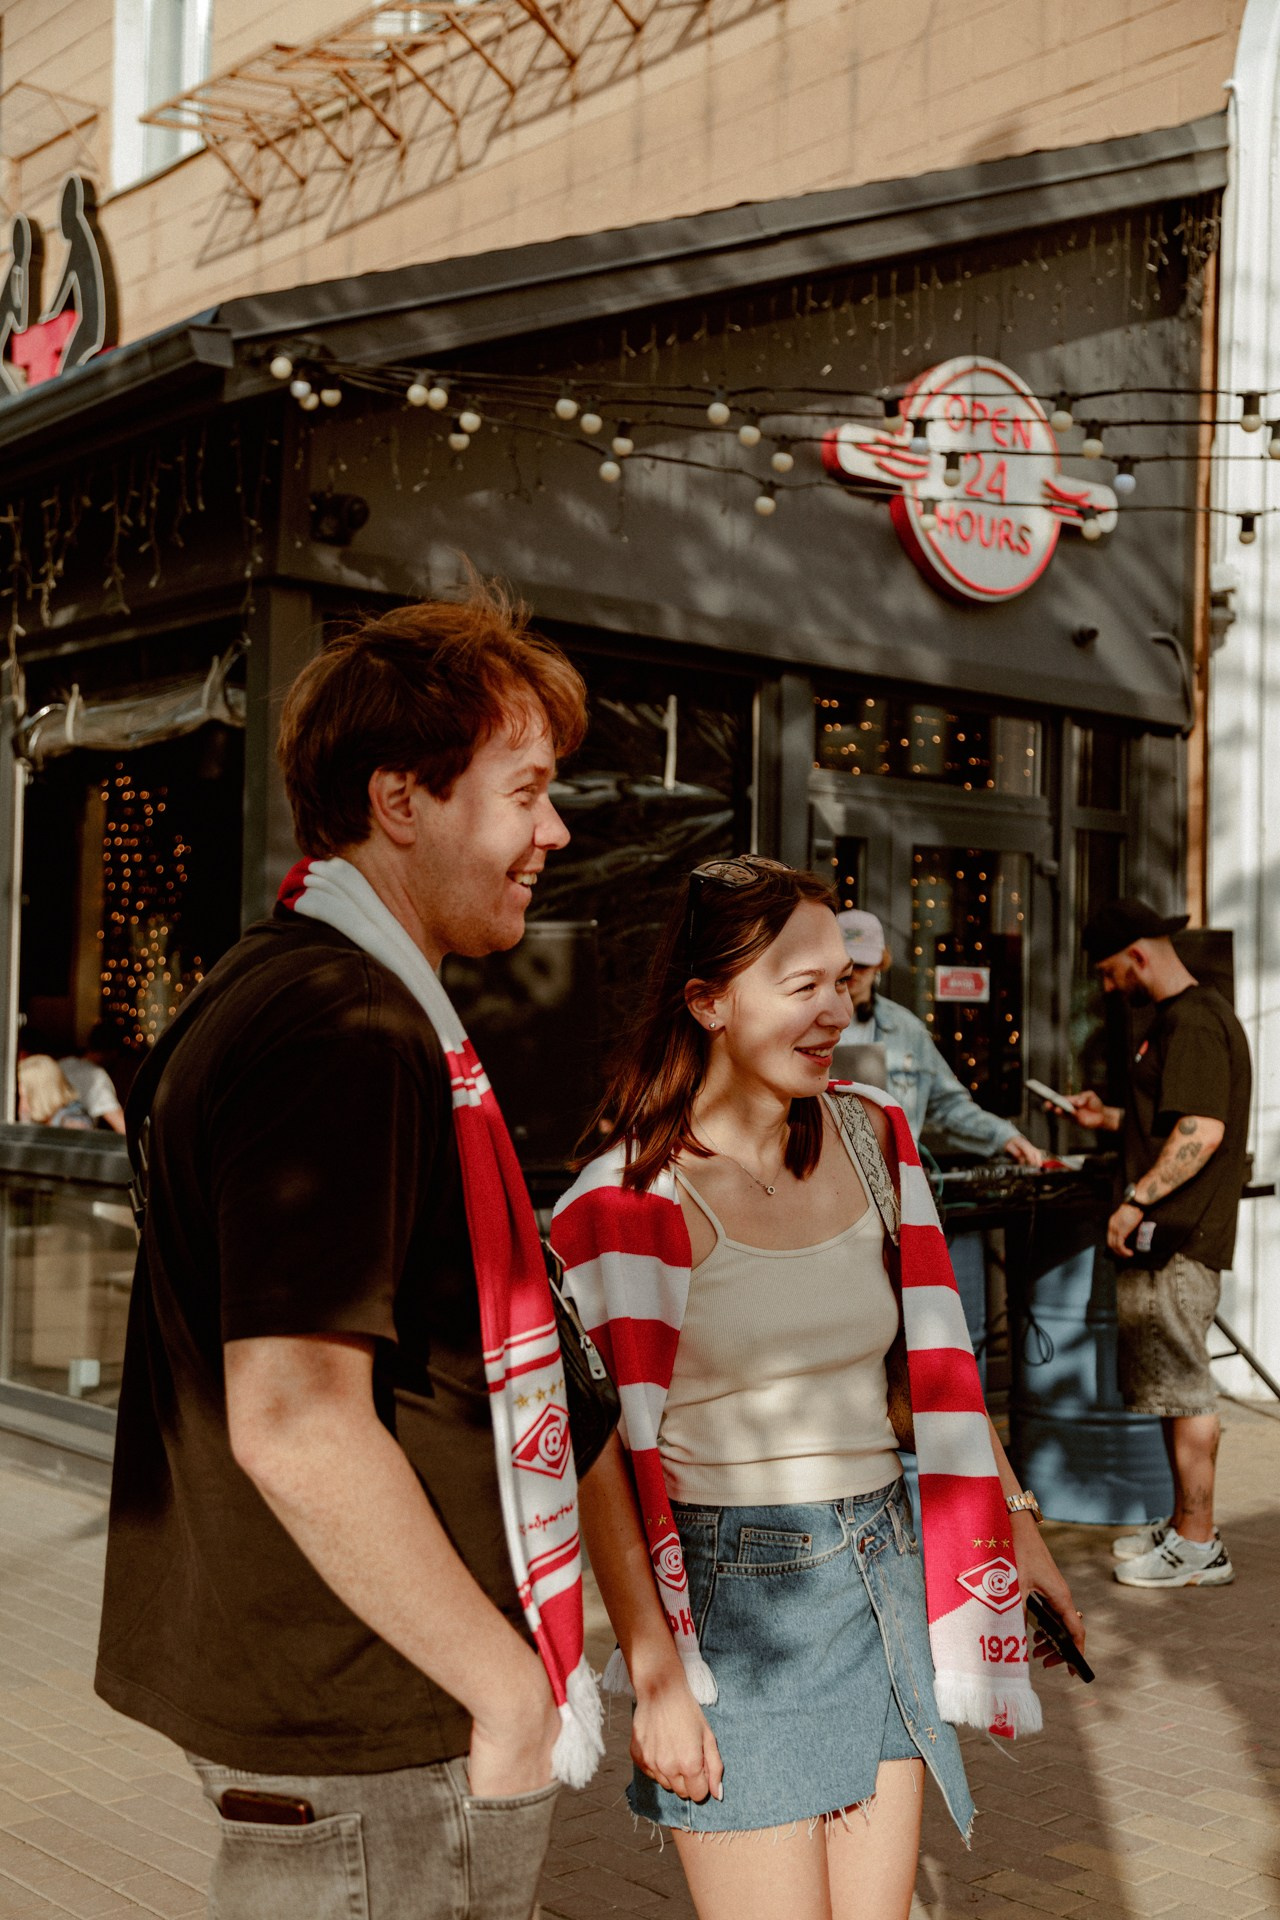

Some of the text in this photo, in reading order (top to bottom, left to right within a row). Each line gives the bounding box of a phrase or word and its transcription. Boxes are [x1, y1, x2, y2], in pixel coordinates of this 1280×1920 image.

[945, 394, 1032, 449] OPEN
[964, 452, 1007, 504] 24
[936, 504, 1032, 556] HOURS
